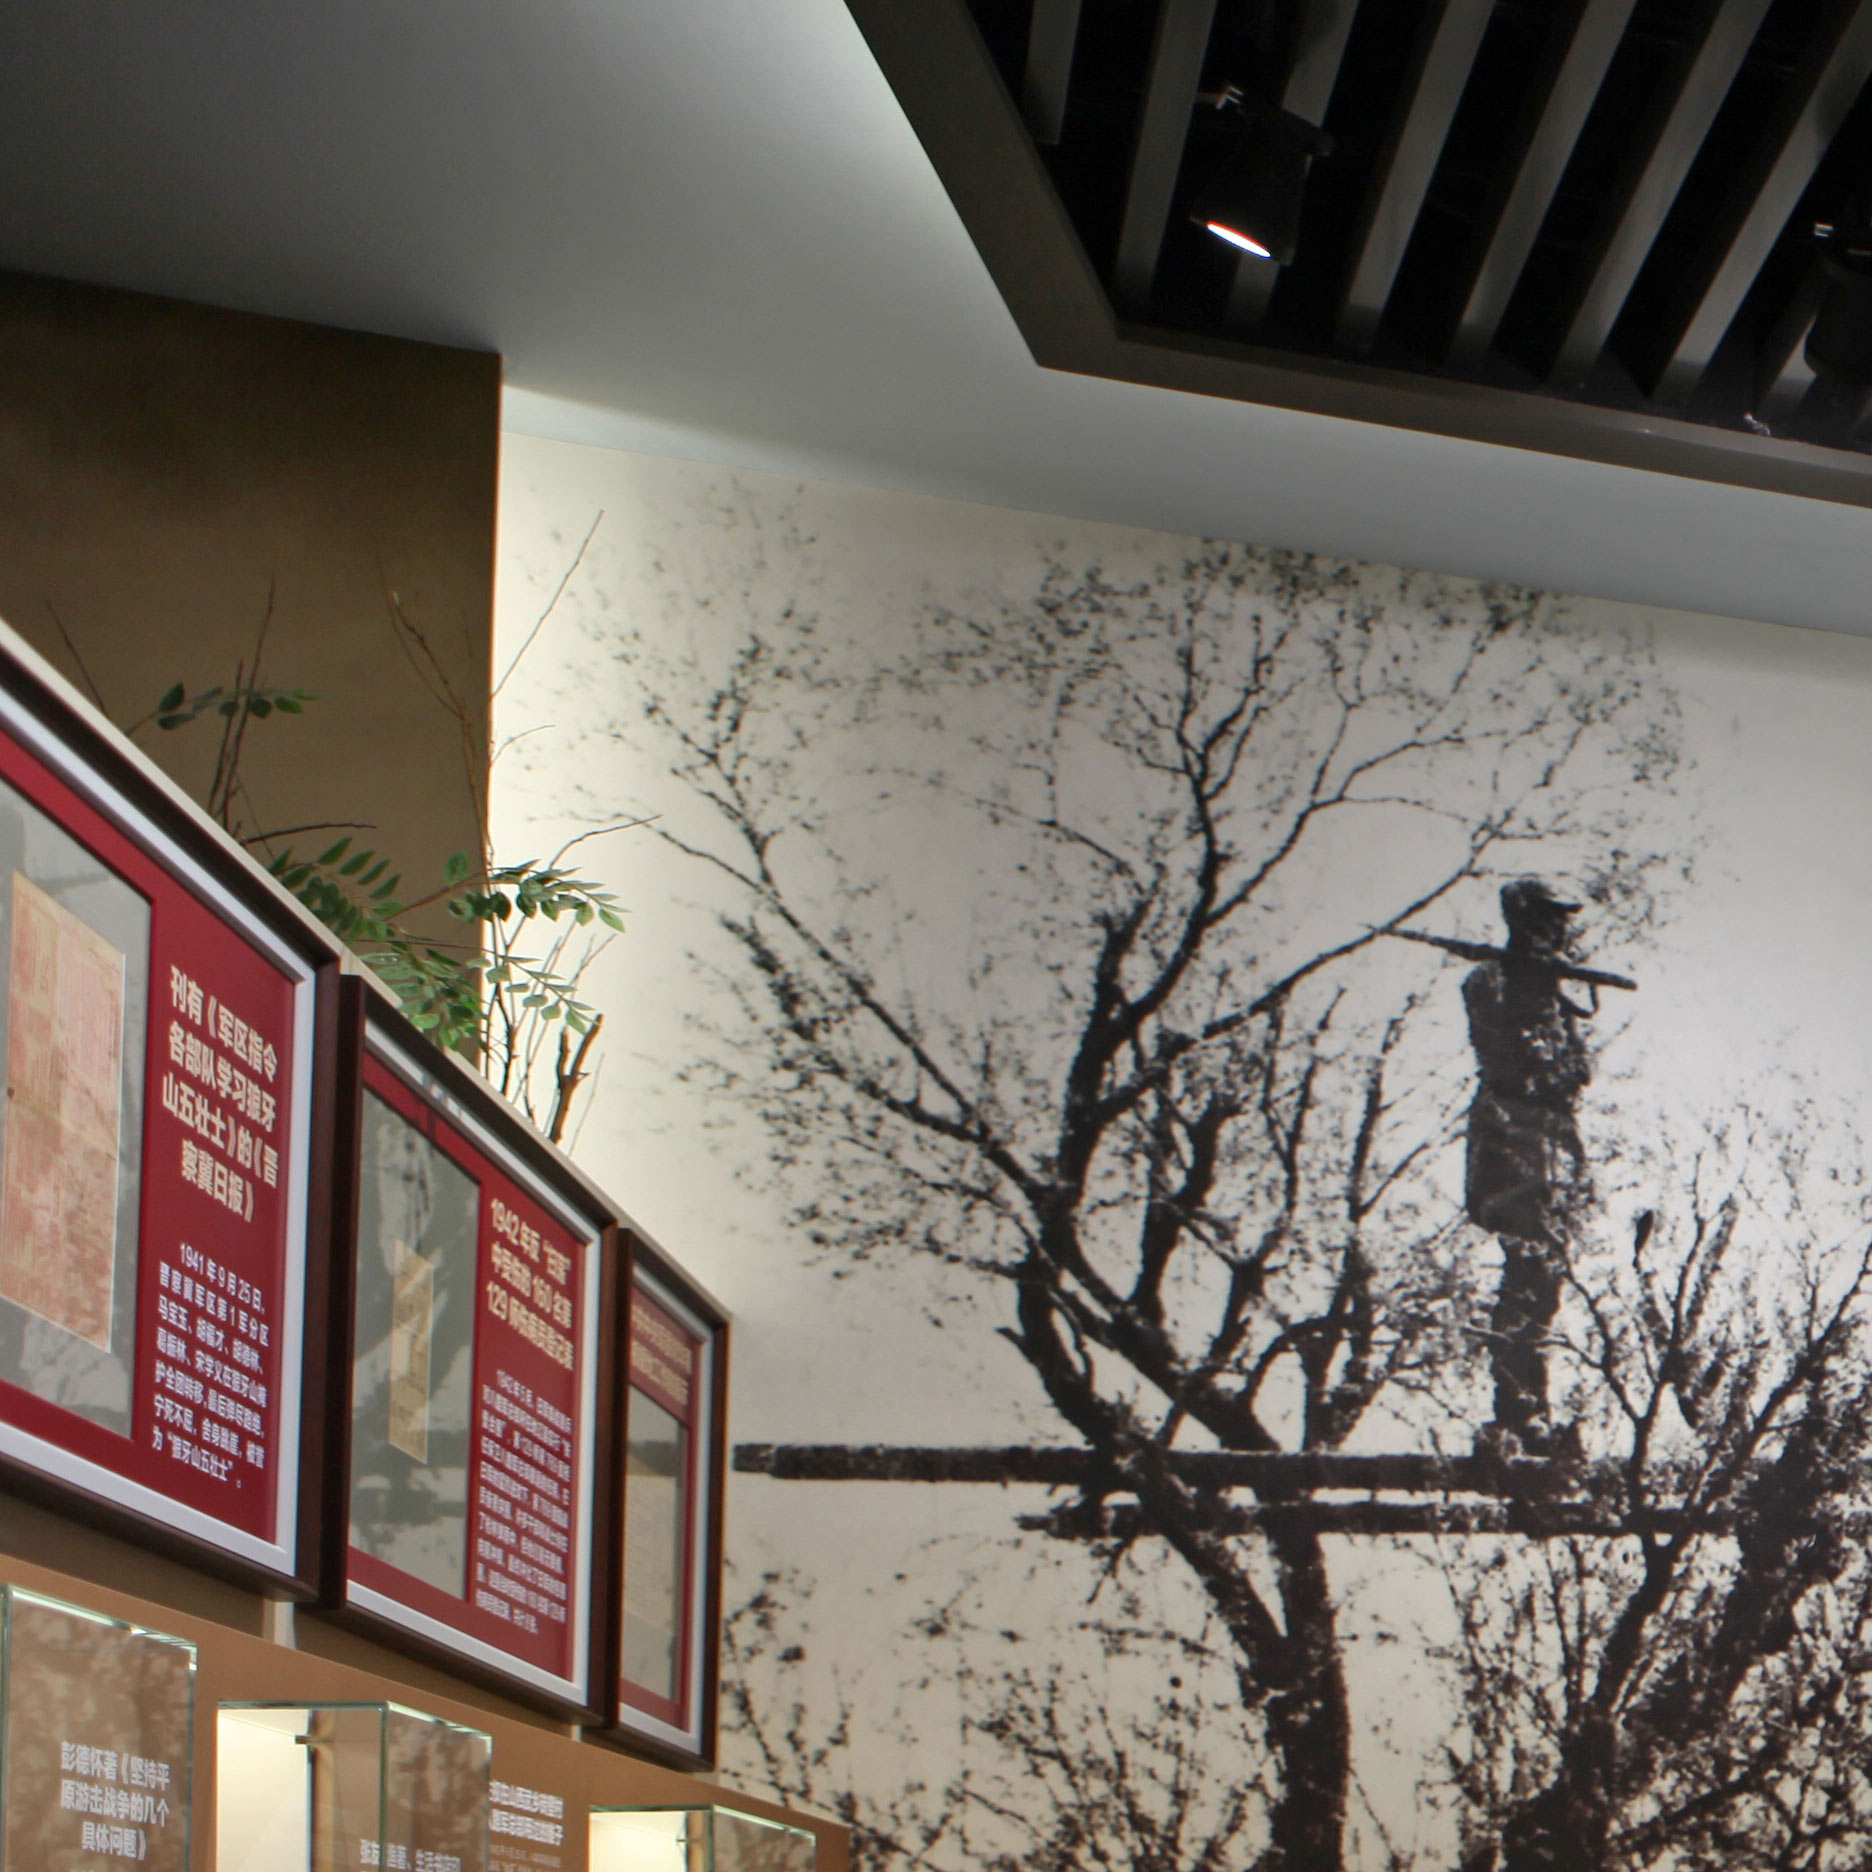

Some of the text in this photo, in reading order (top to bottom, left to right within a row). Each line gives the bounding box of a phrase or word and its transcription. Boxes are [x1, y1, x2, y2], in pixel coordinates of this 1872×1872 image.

[171, 965, 278, 1083] 刊有《军区指令
[169, 1020, 276, 1132] 各部队学习狼牙
[162, 1072, 278, 1188] 山五壮士》的《晋
[181, 1138, 254, 1223] 察冀日报》
[60, 1780, 169, 1827] 原游击战争的几个
[61, 1741, 170, 1791] 彭德怀著《坚持平
[82, 1821, 146, 1860] 具体问题》
